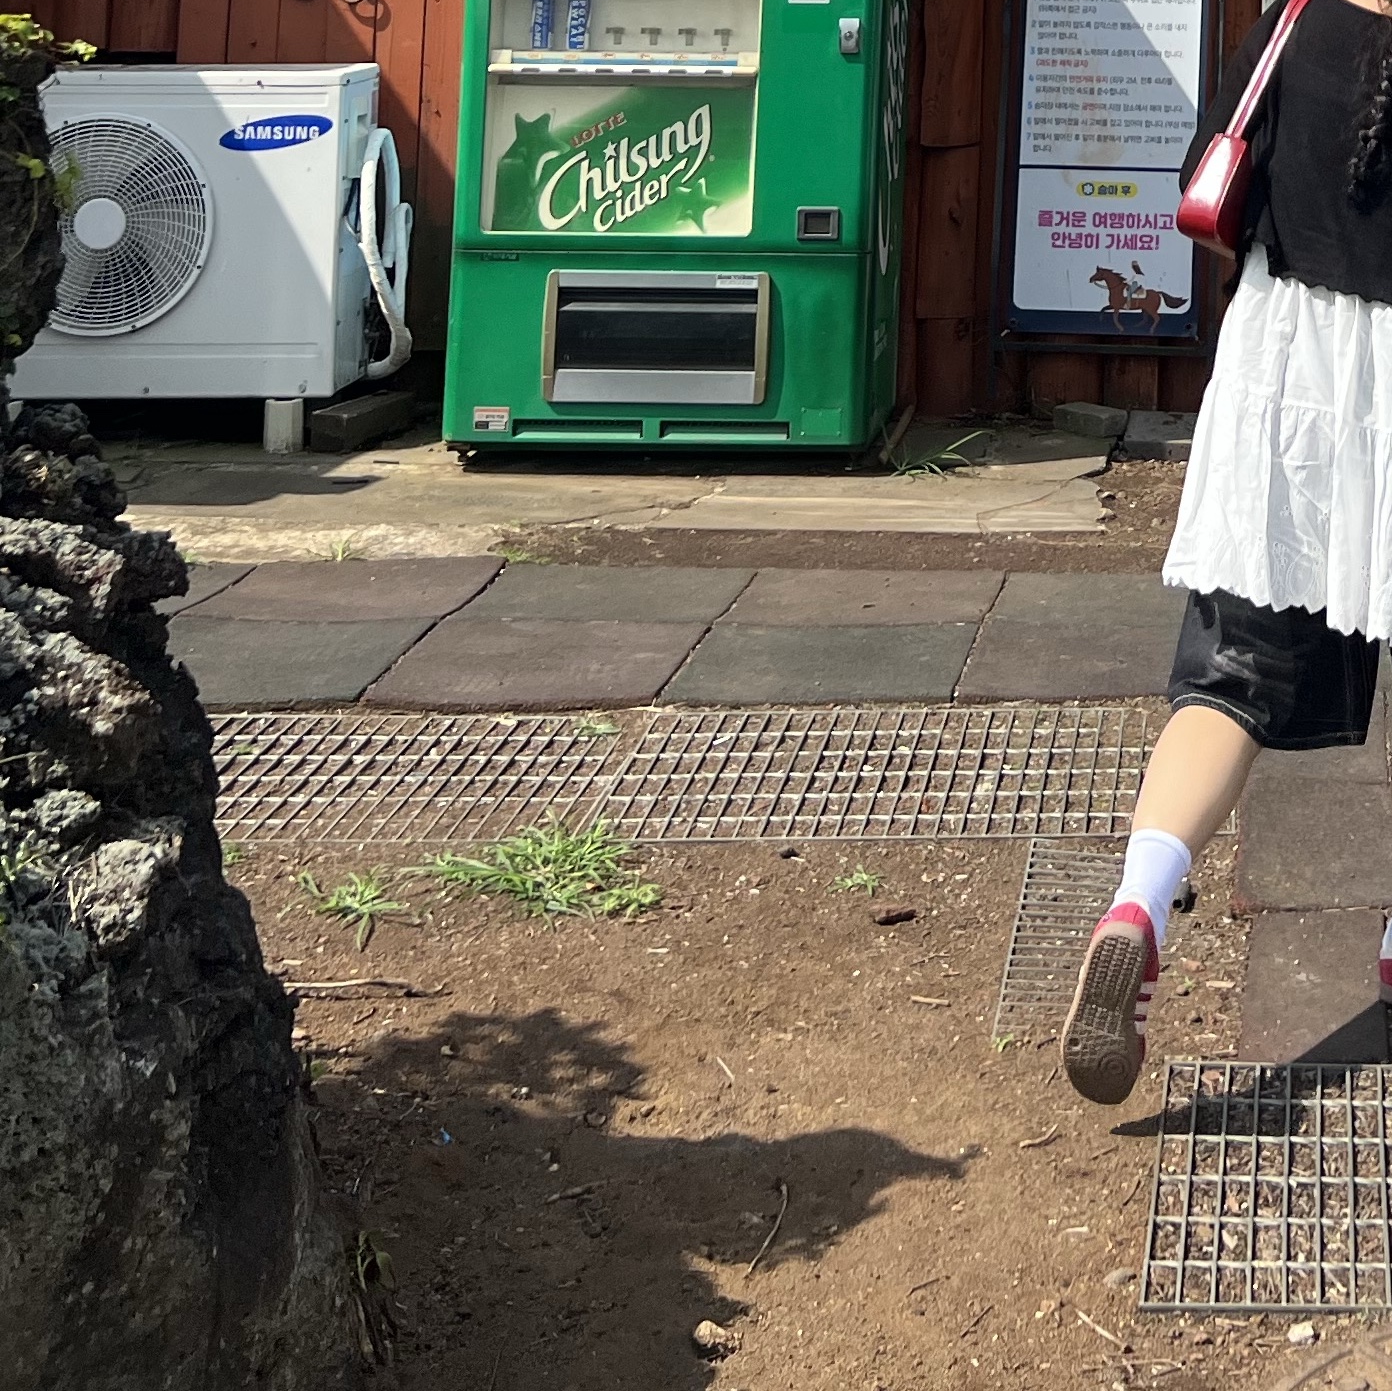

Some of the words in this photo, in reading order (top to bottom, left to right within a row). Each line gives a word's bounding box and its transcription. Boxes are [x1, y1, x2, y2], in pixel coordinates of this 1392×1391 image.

[233, 124, 320, 141] SAMSUNG
[537, 103, 712, 231] Chilsung
[593, 158, 688, 233] Cider
[1038, 210, 1086, 228] 즐거운
[1092, 212, 1174, 230] 여행하시고
[1052, 232, 1099, 249] 안녕히
[1105, 233, 1160, 250] 가세요!
